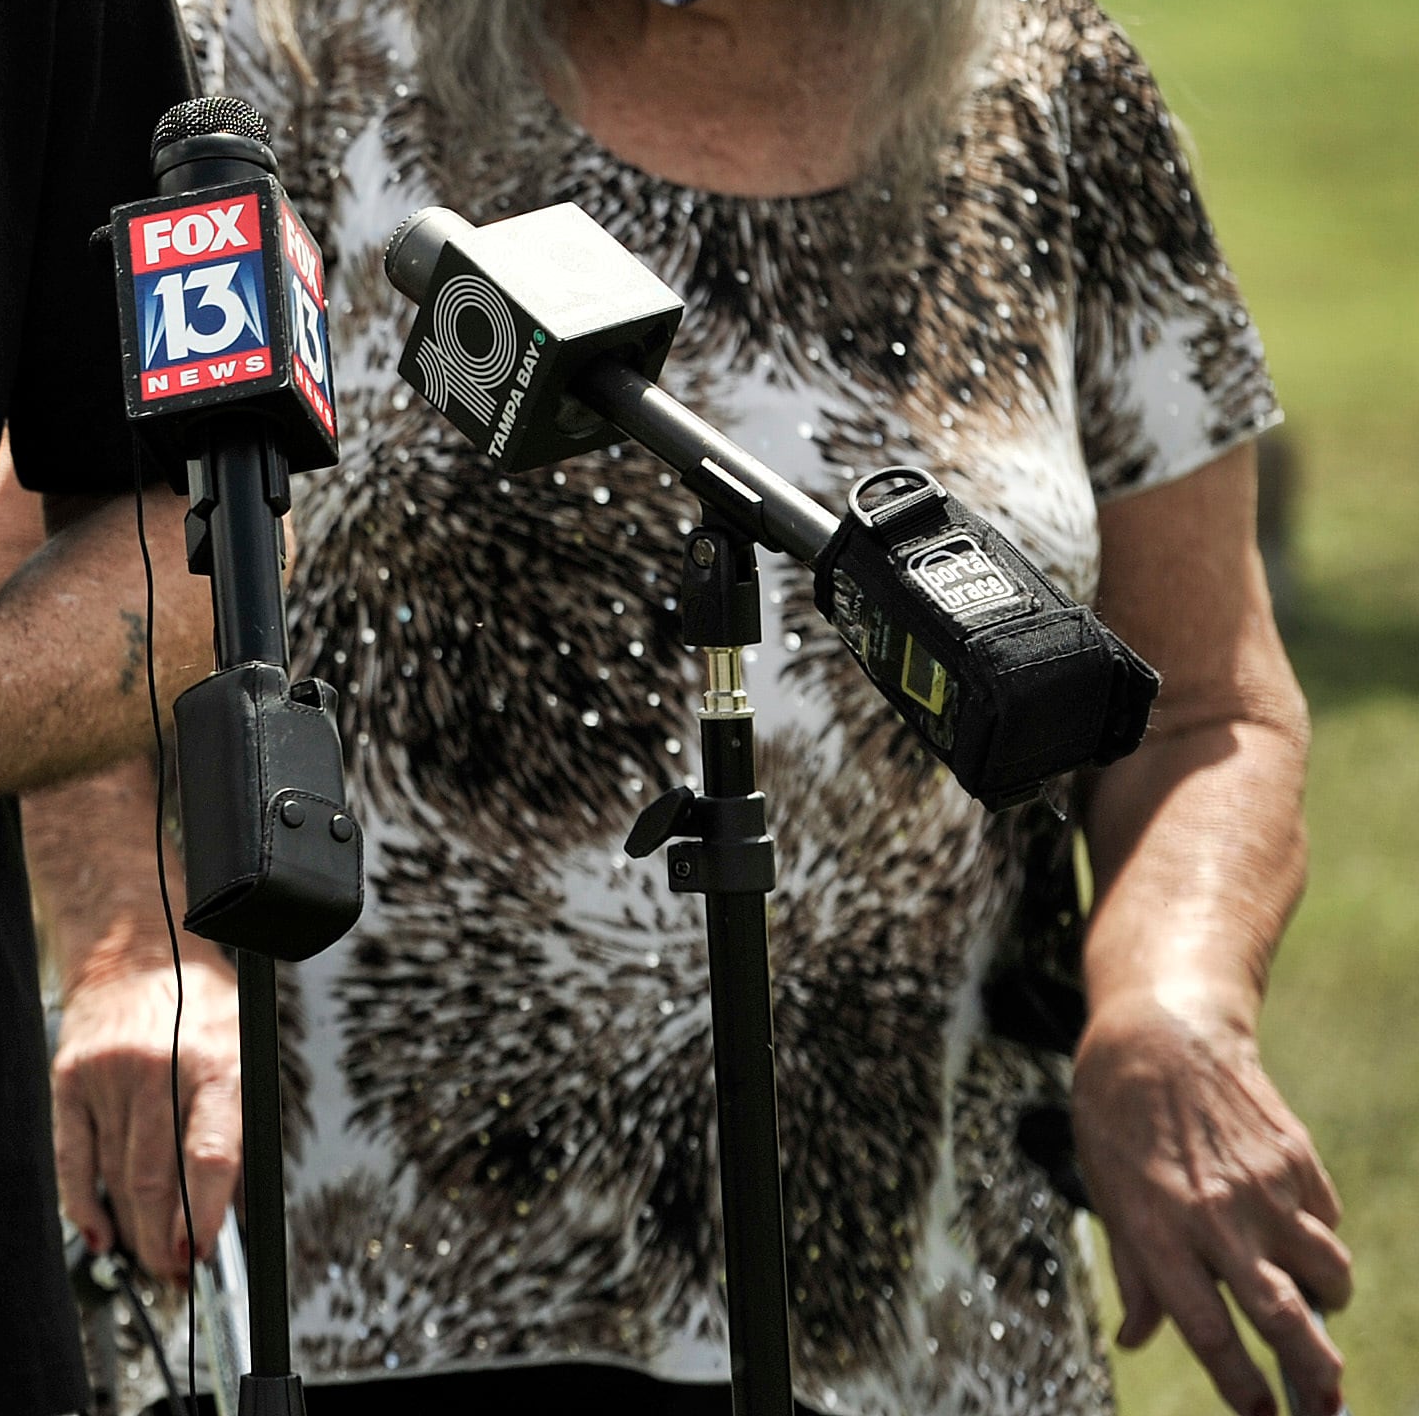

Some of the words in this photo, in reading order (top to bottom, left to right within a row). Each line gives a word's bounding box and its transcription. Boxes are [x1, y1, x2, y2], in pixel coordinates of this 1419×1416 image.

[143, 203, 249, 266] FOX
[284, 212, 320, 300] FOX
[153, 261, 247, 361] 13
[292, 275, 325, 385] 13
[147, 355, 266, 394] NEWS
[295, 360, 334, 429] NEWS
[487, 385, 525, 460] TAMPA
[516, 341, 543, 393] BAY
[922, 551, 991, 588] porta
[941, 575, 1006, 608] brace
